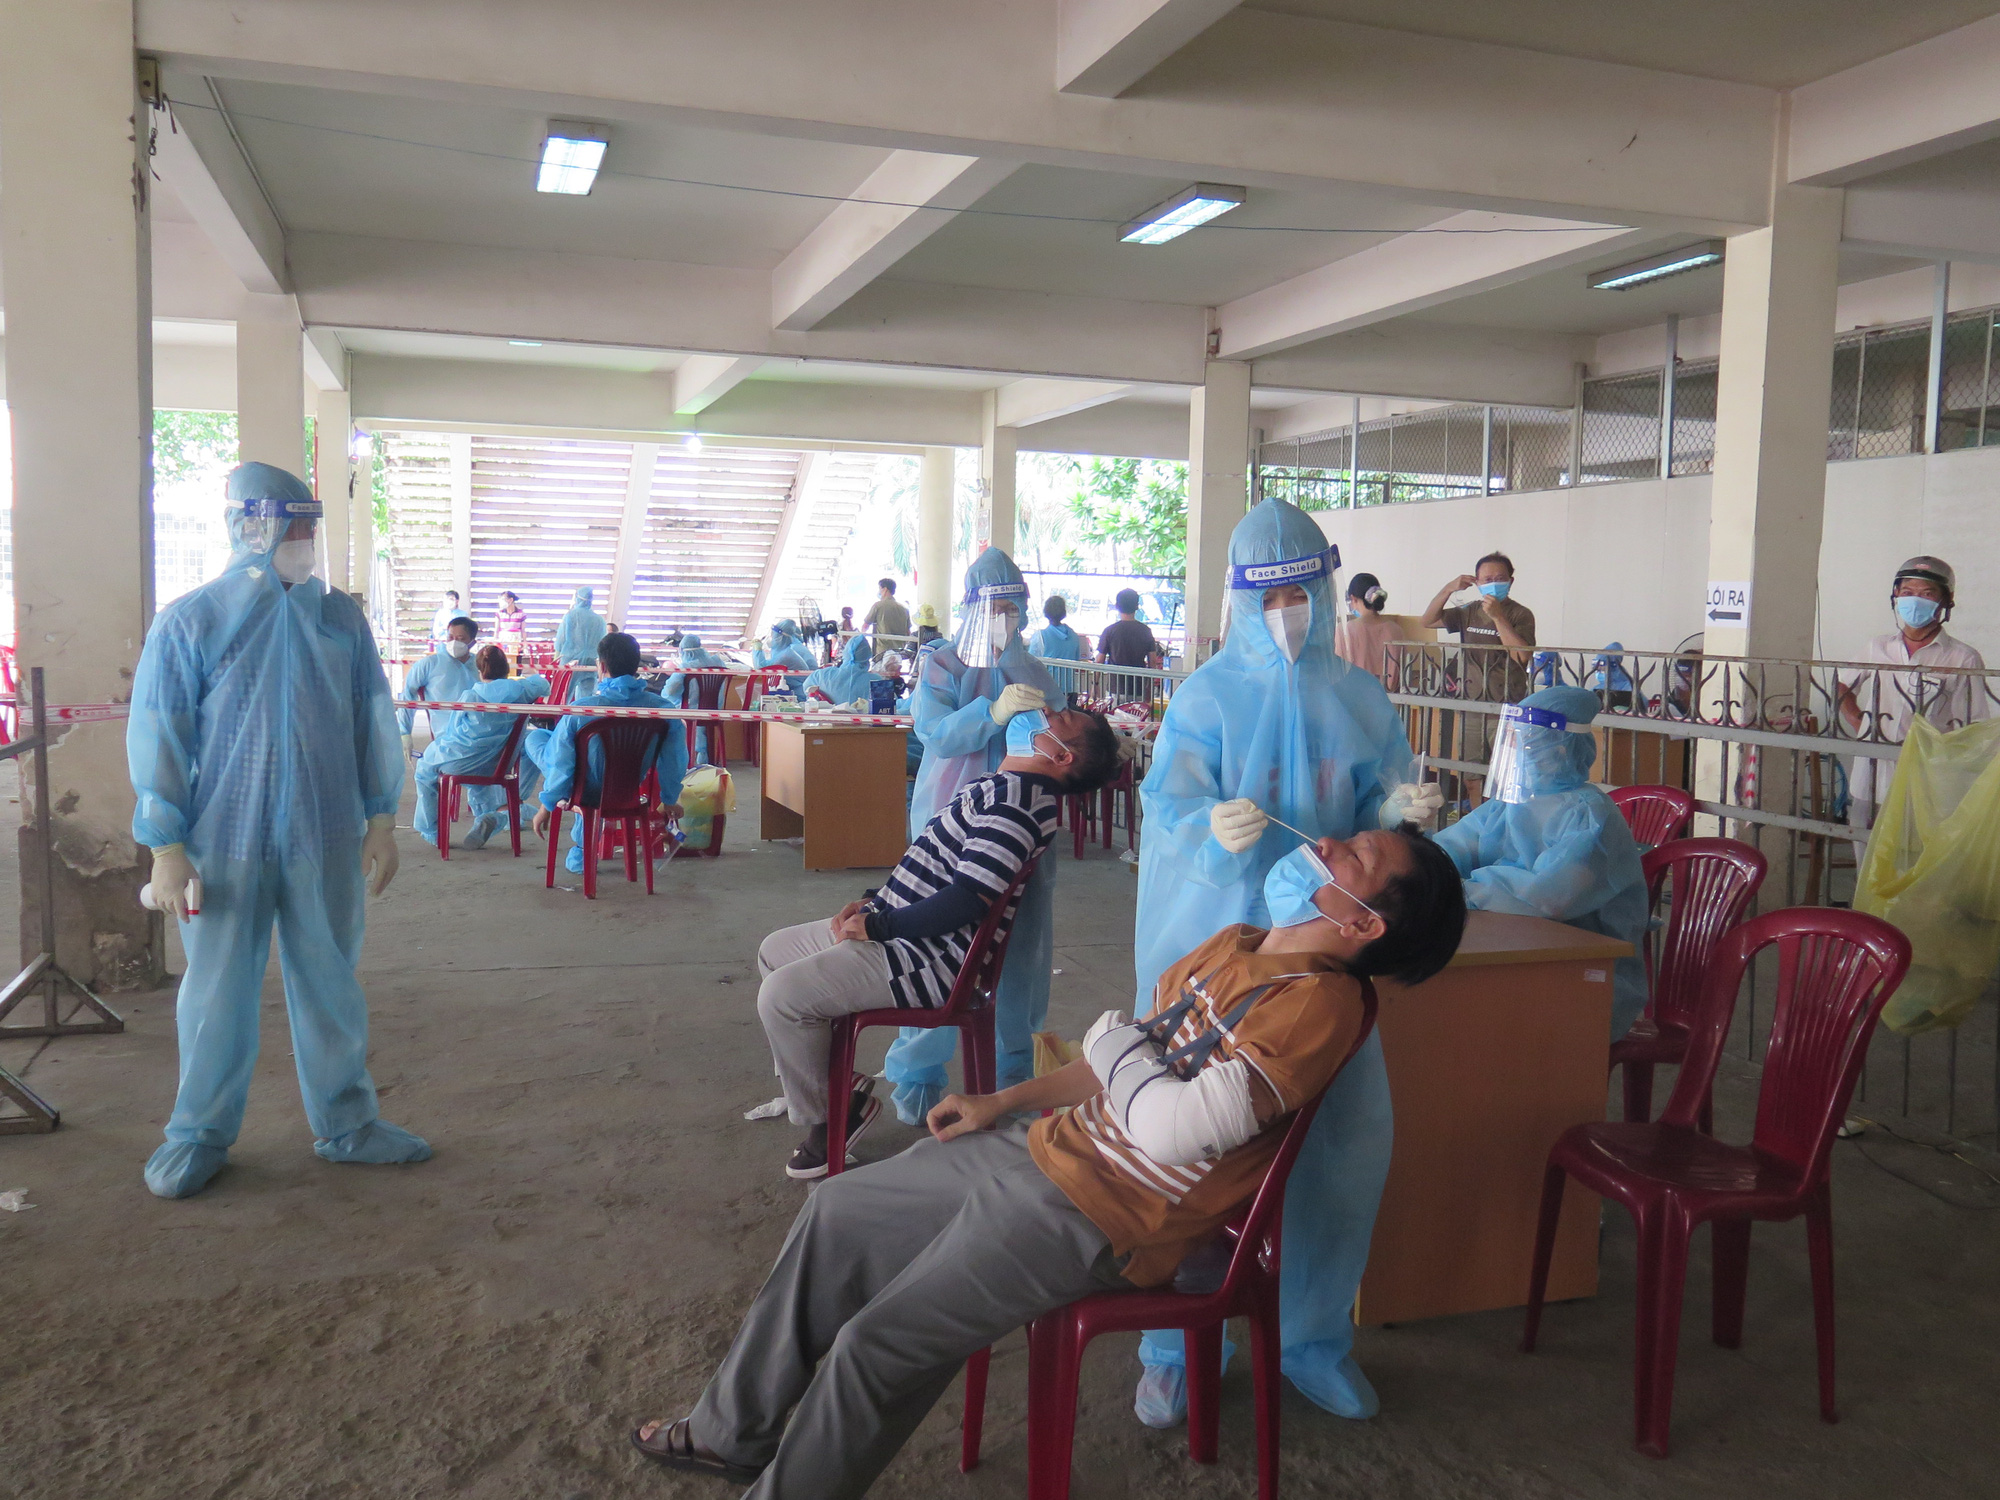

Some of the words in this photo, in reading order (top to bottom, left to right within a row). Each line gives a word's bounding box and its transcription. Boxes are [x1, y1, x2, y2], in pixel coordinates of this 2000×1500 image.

[1251, 569, 1276, 579] Face
[1281, 560, 1317, 575] Shield
[1271, 578, 1289, 586] Splash
[1000, 585, 1022, 593] Shield
[1728, 589, 1745, 607] RA
[1466, 626, 1496, 635] CONVERSE
